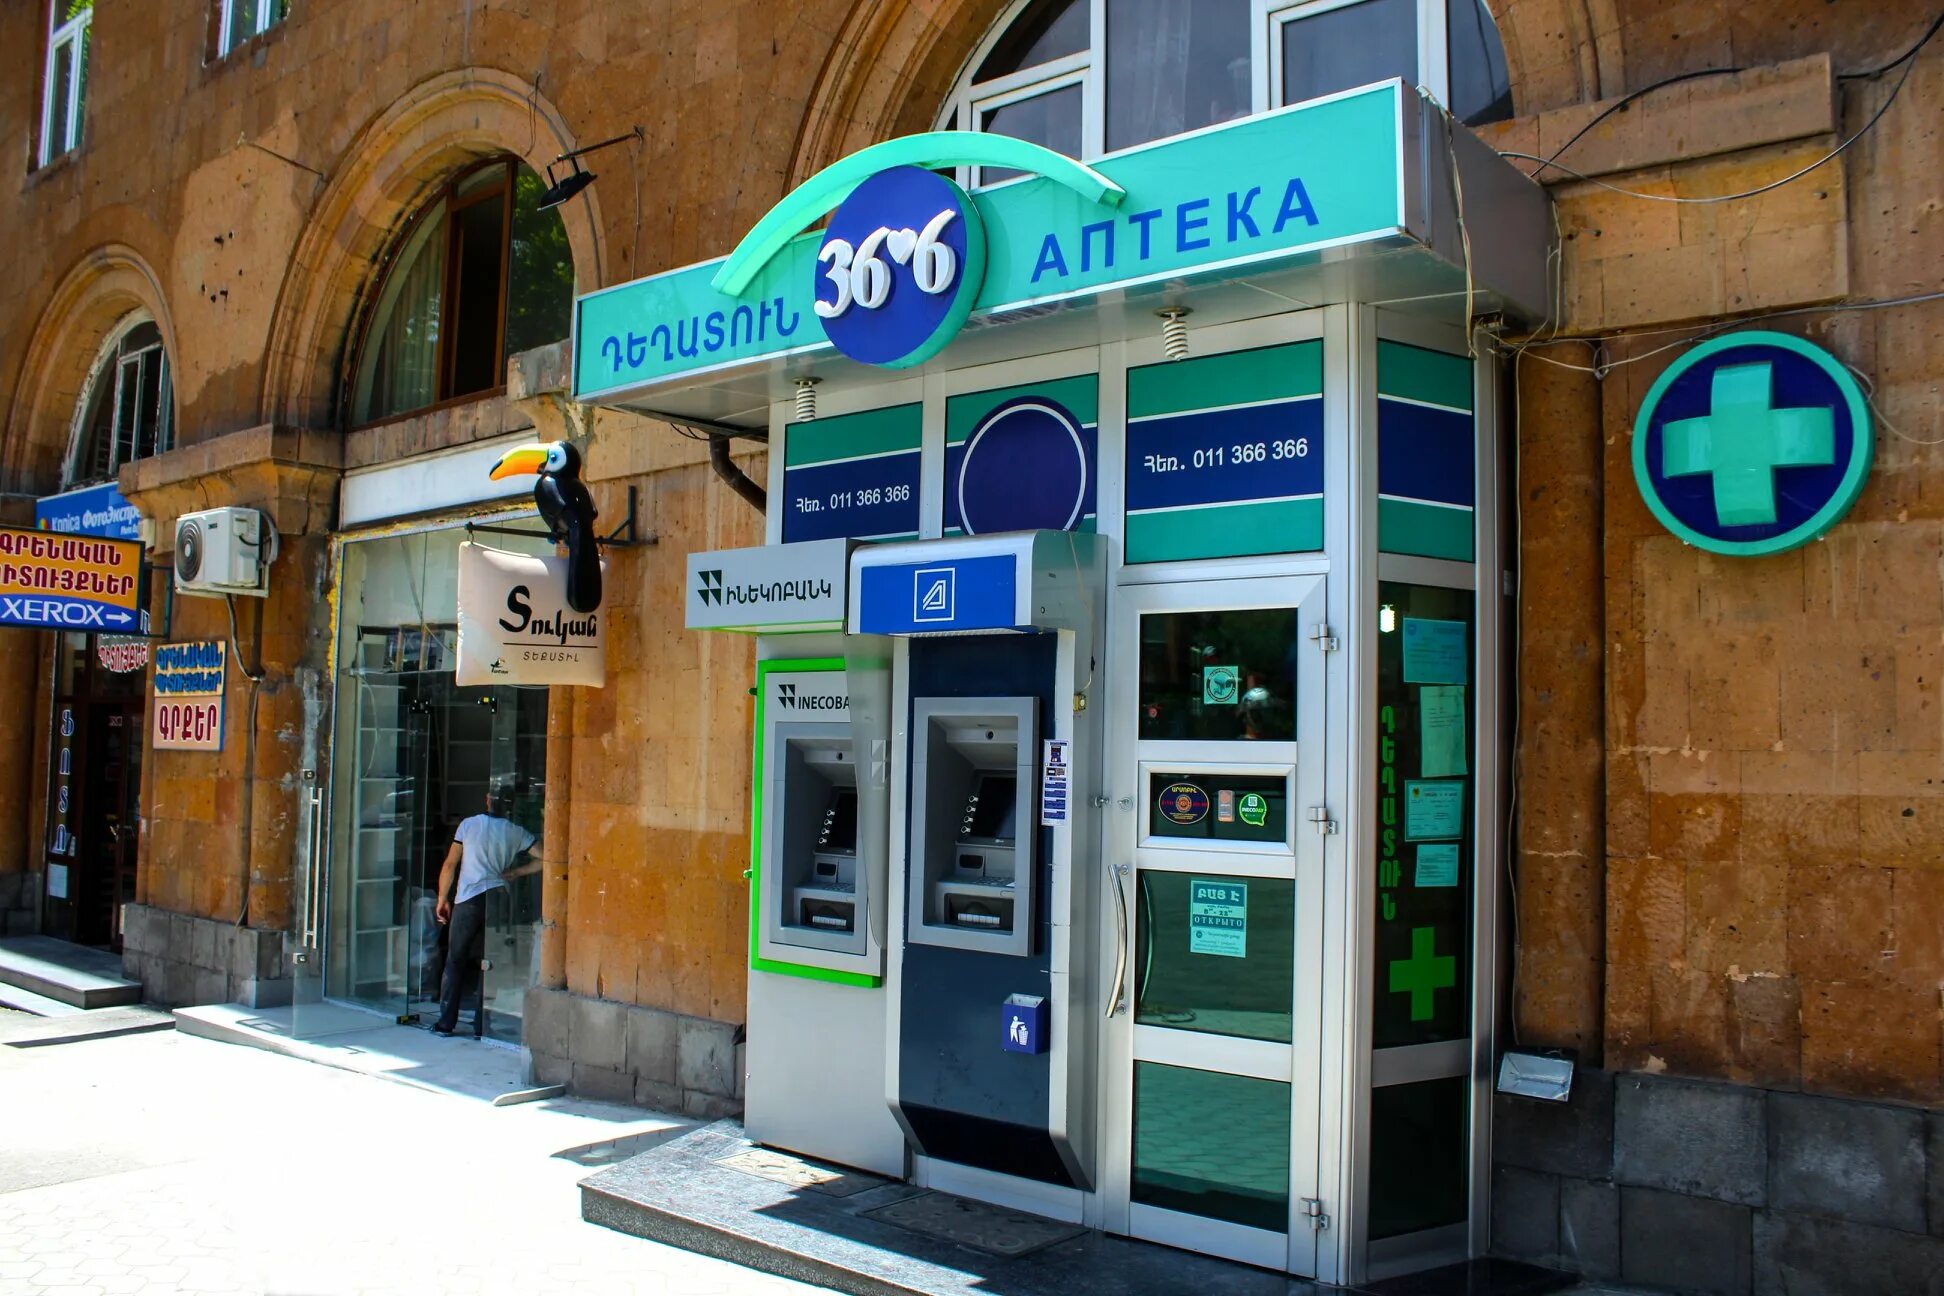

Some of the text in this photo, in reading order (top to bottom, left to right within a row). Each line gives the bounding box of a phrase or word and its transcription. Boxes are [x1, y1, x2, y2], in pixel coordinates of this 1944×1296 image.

[1031, 178, 1319, 283] АПТЕКА
[602, 297, 799, 372] ԴԵՂԱՏՈՒՆ
[1193, 447, 1224, 469] 011
[1231, 442, 1267, 464] 366
[1272, 437, 1308, 460] 366
[830, 491, 852, 509] 011
[856, 488, 881, 506] 366
[884, 484, 910, 503] 366
[0, 533, 122, 566] ԳՐԵՆԱԿԱՆ
[0, 563, 135, 596] ԻՏՈՒՅՔՆԵՐ
[726, 578, 832, 606] ԻՆԵԿՈԲԱՆԿ
[1, 597, 105, 626] XEROX
[523, 650, 580, 663] ՏԵՔՍՏԻԼ
[798, 695, 849, 709] INECOBA
[160, 704, 216, 741] ԳՐՔԵՐ
[1197, 888, 1226, 900] ԲԱՑ
[1194, 916, 1242, 927] ОТКРЫТО
